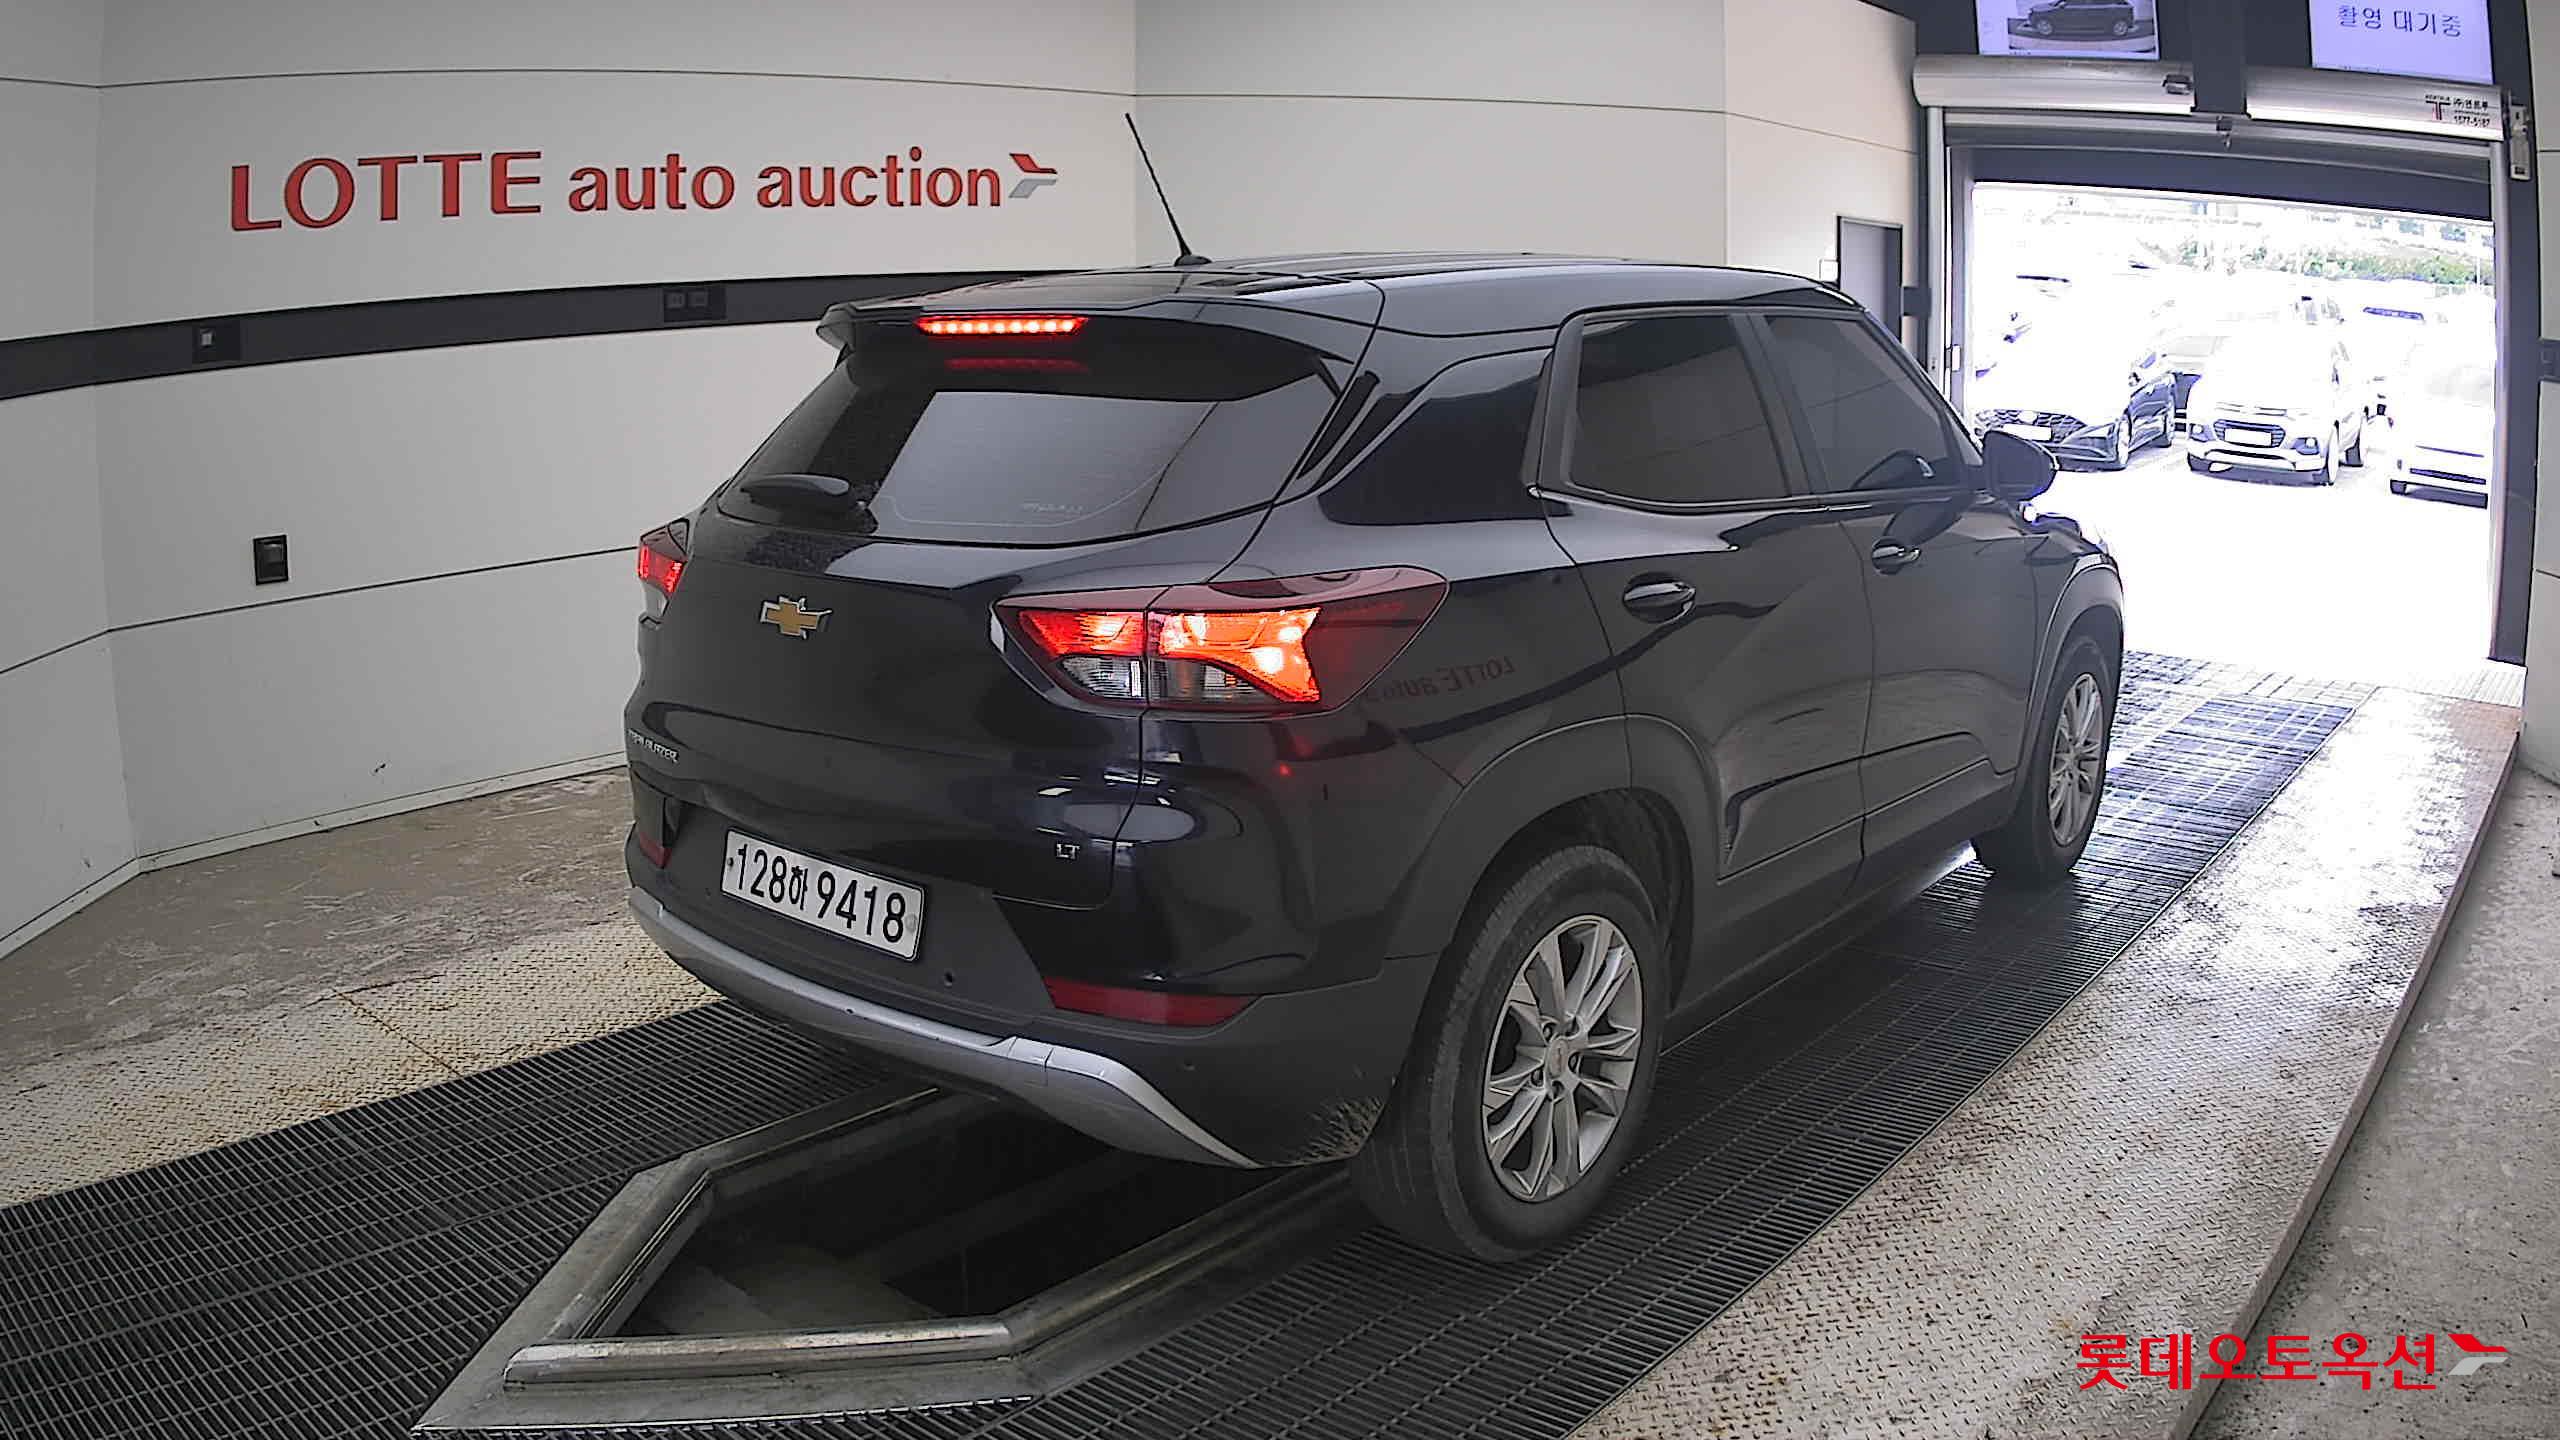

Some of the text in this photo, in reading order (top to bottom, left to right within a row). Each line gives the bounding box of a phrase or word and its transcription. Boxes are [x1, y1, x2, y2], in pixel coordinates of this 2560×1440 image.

[2339, 5, 2461, 37] 촬영 대기중
[232, 146, 1002, 231] LOTTE auto auction
[1056, 843, 1081, 860] LT
